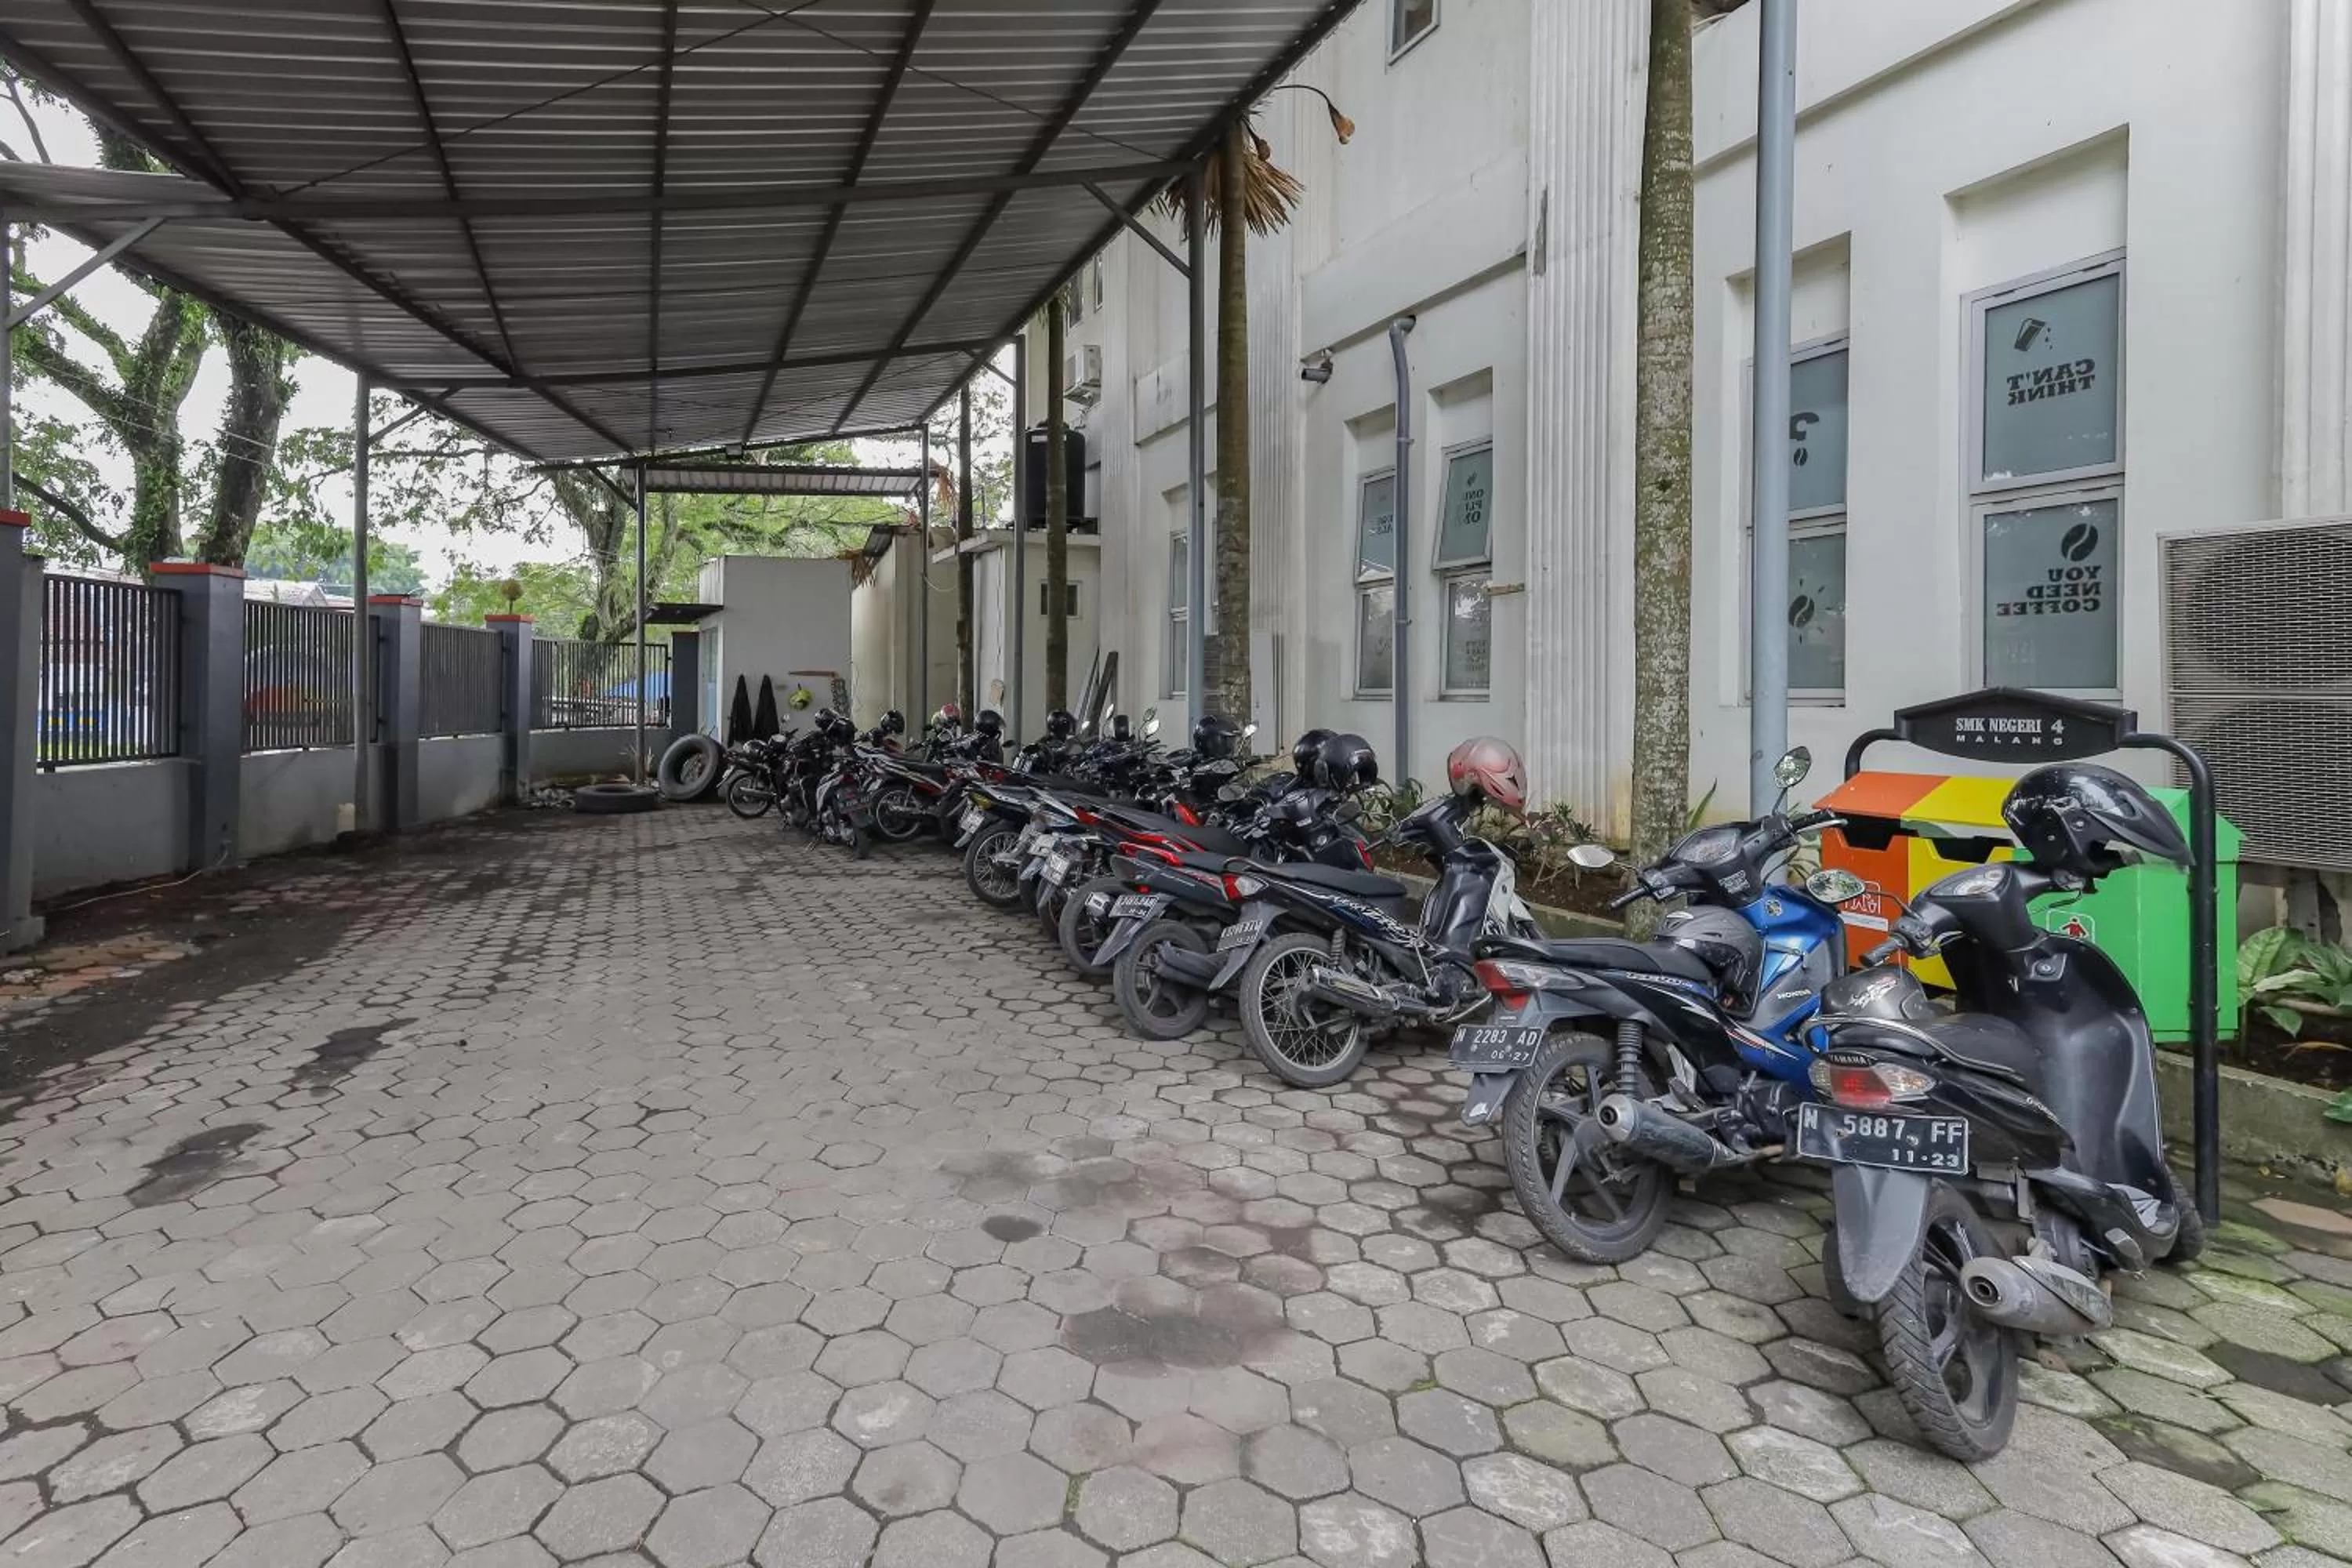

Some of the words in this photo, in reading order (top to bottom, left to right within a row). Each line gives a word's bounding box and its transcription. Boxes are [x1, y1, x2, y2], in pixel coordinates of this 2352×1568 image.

[1956, 717, 1985, 731] SMK
[1989, 718, 2042, 733] NEGERI
[2051, 719, 2064, 734] 4
[1956, 735, 2063, 745] MALANG
[1456, 1028, 1467, 1042] N
[1516, 1030, 1537, 1047] AD
[1804, 1108, 1818, 1130] N
[1843, 1114, 1906, 1140] 5887
[1930, 1121, 1962, 1144] FF
